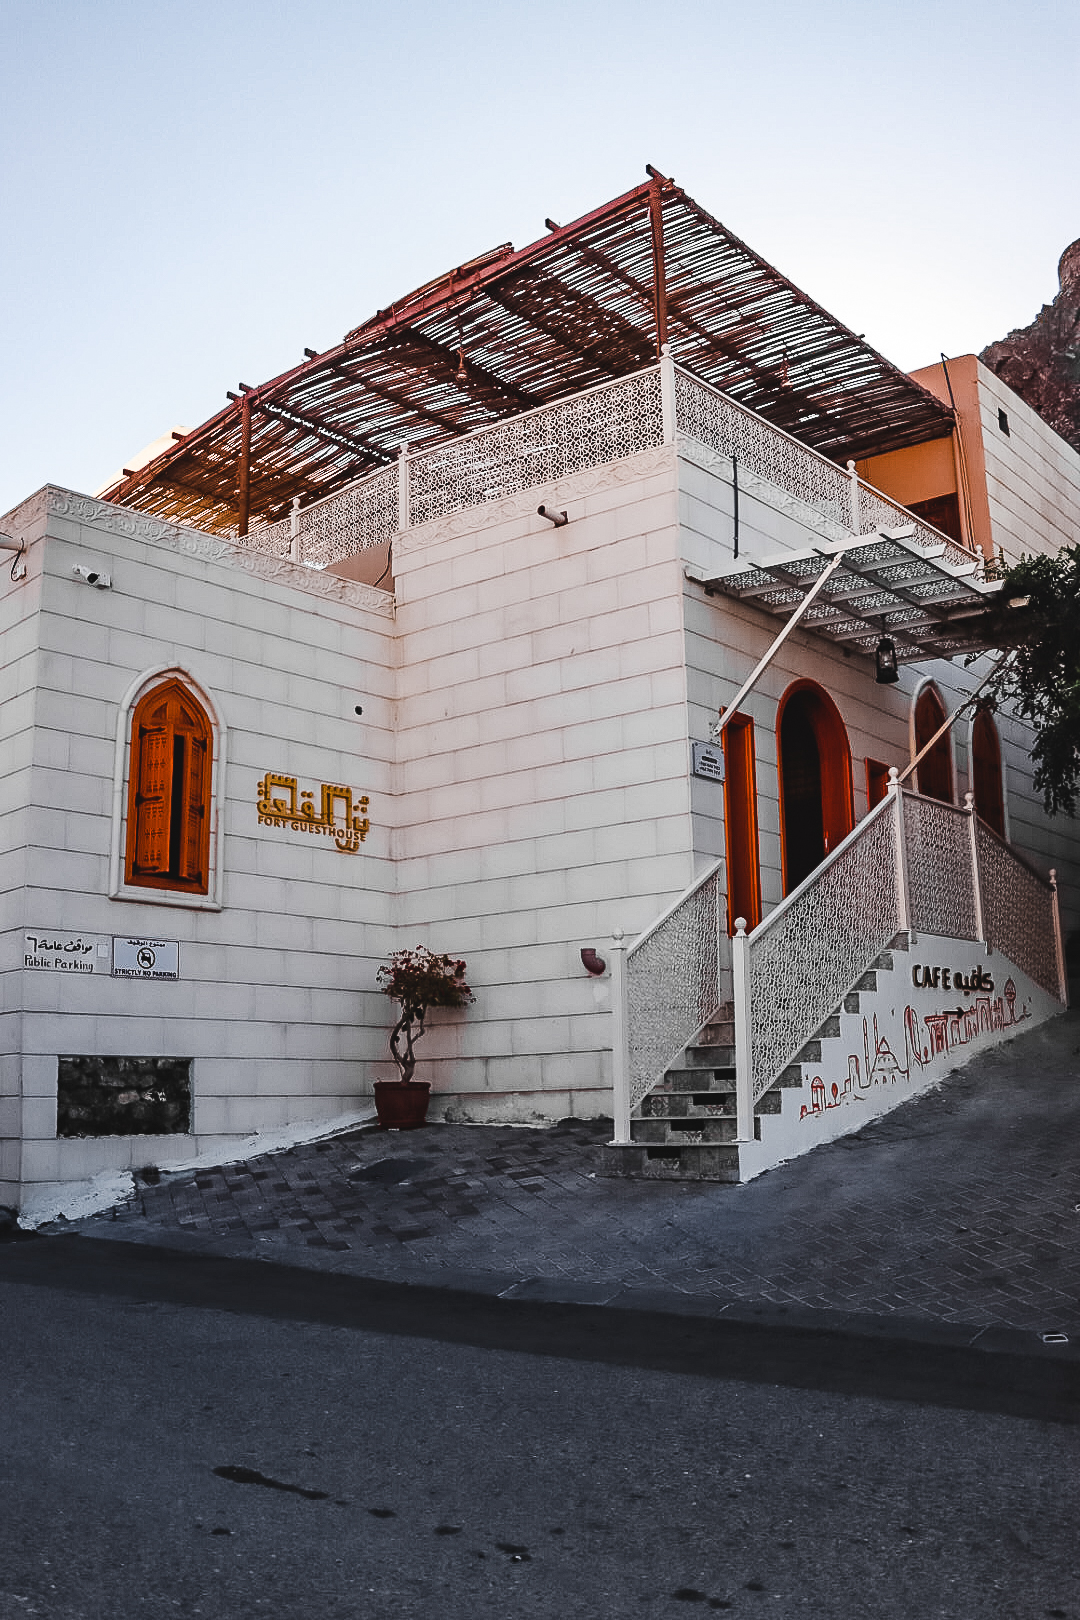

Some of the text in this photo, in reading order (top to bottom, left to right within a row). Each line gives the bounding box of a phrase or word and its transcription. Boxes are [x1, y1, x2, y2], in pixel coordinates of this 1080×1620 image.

[257, 815, 366, 843] FORT GUESTHOUSE
[38, 939, 63, 951] عامة
[64, 938, 93, 955] مواقف
[24, 954, 94, 973] Public Parking
[114, 968, 142, 977] STRICTLY
[152, 970, 177, 978] PARKING
[912, 964, 995, 997] CAFE كافيه
